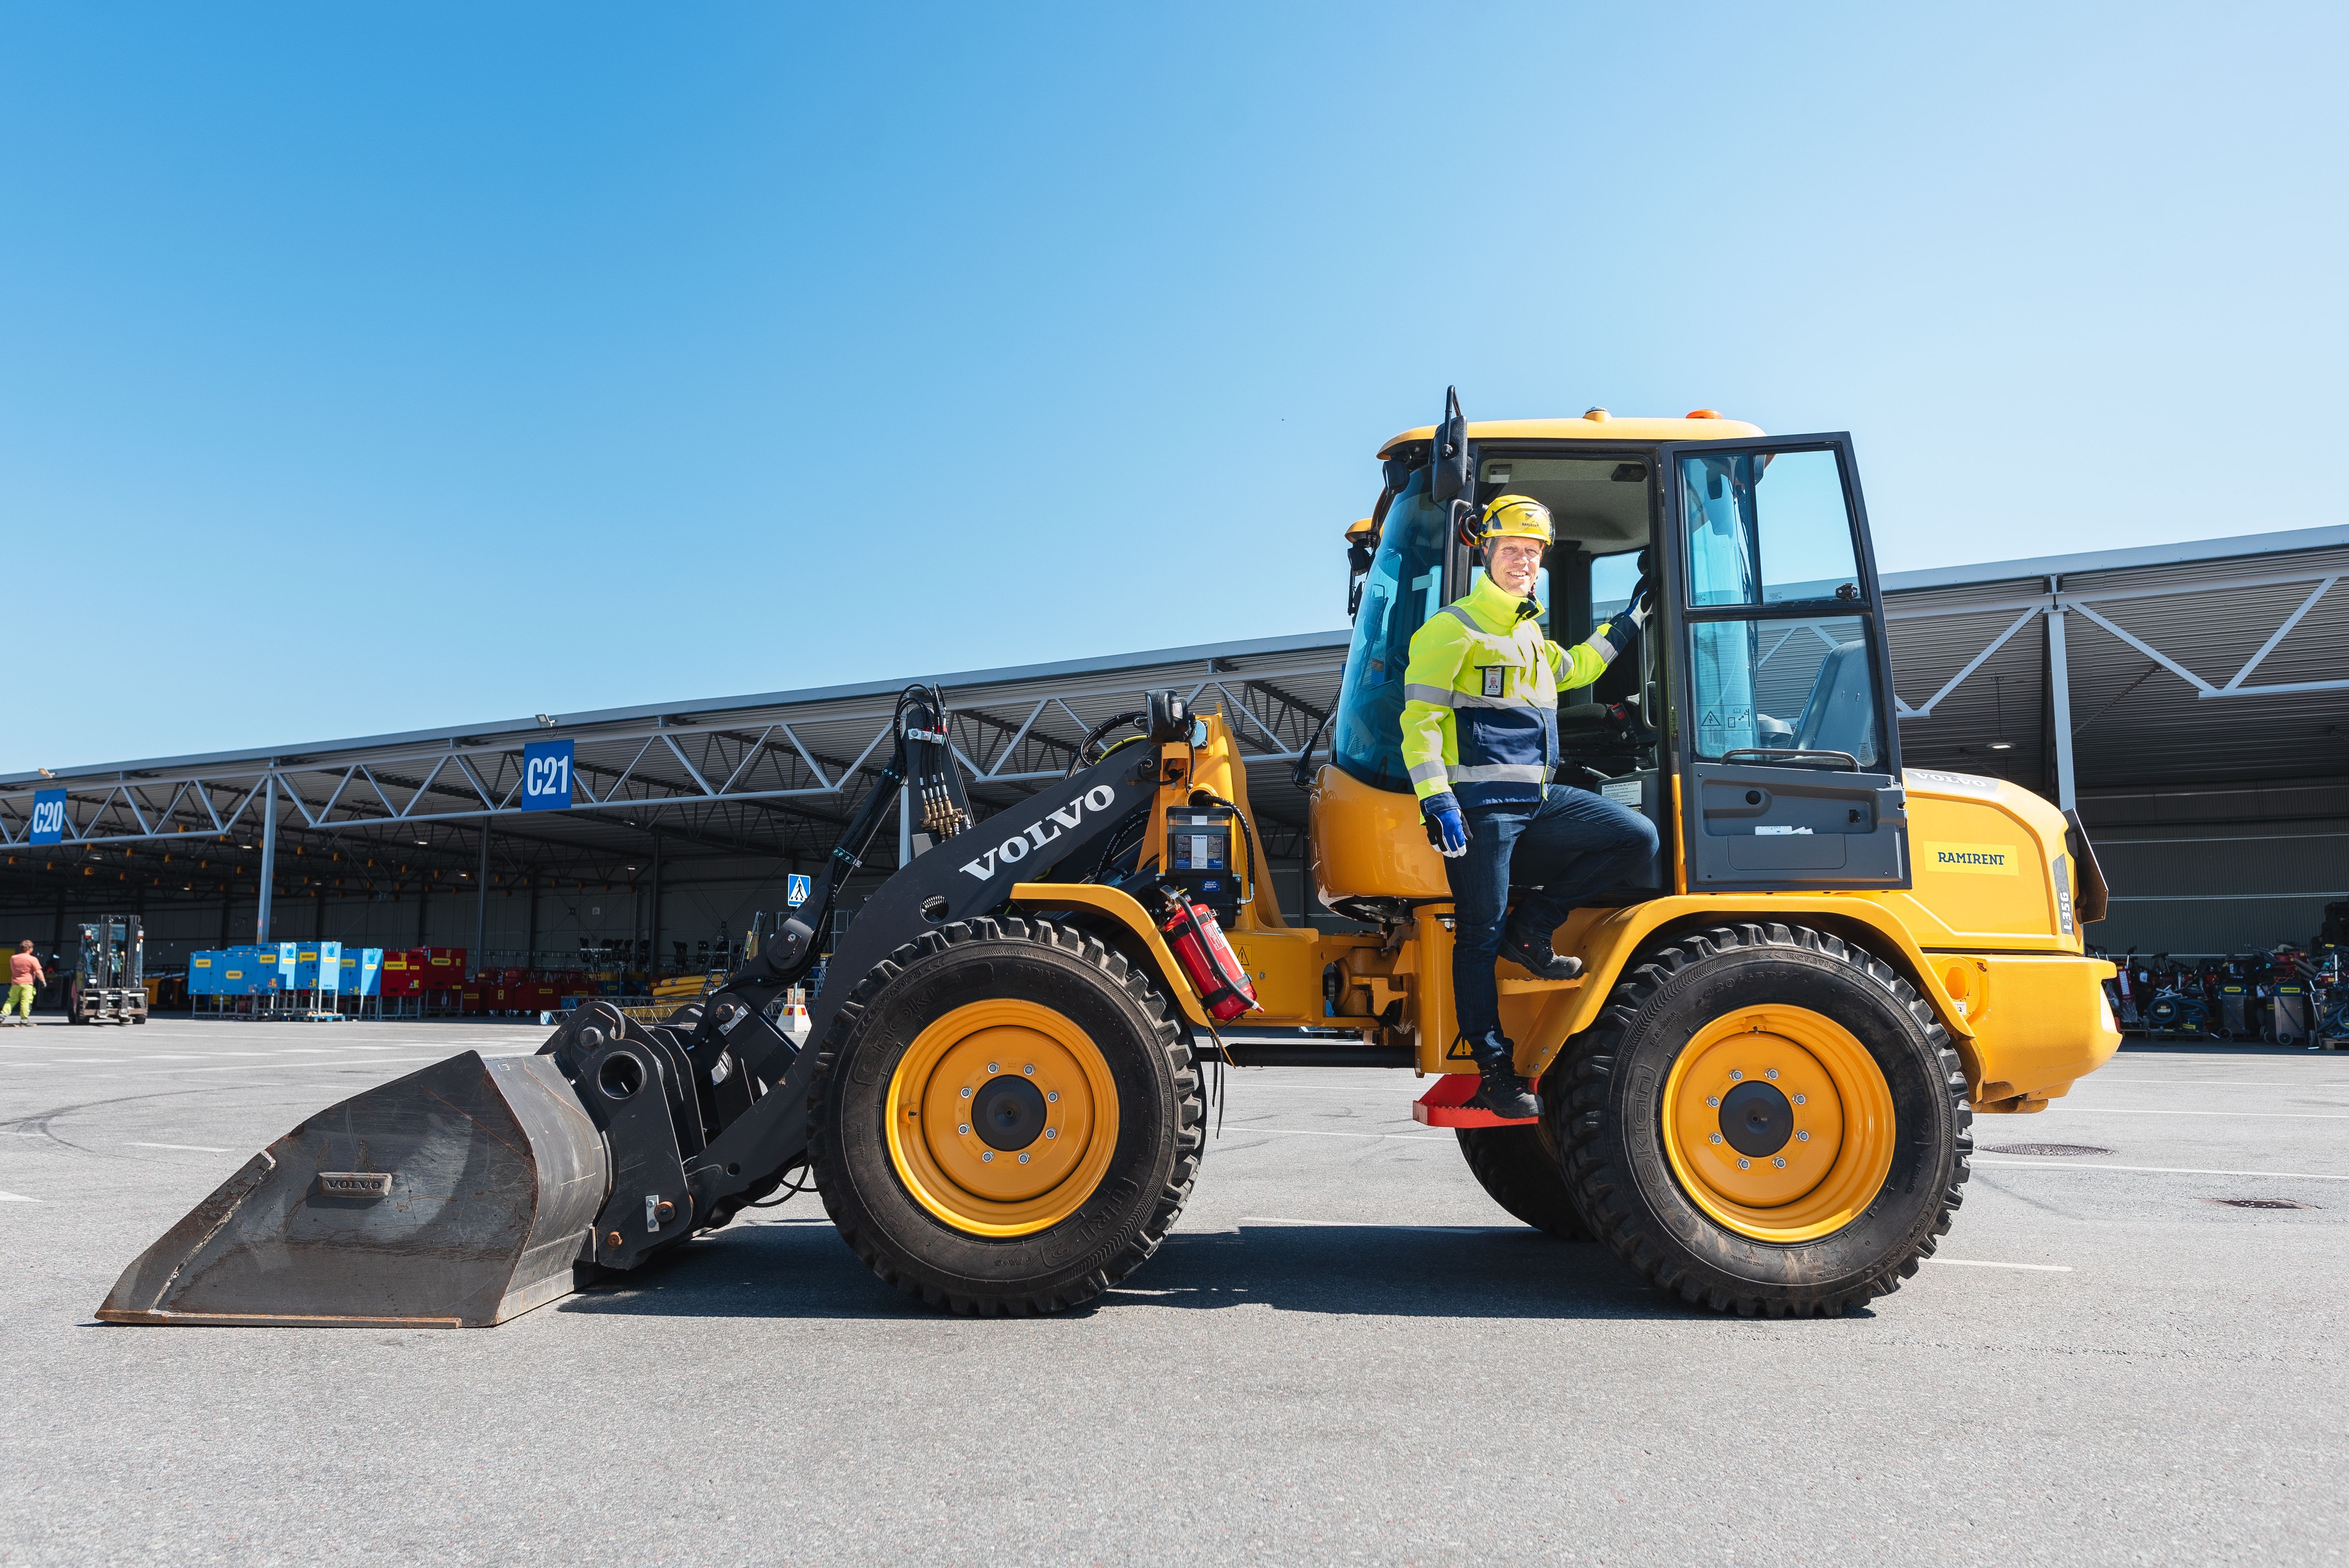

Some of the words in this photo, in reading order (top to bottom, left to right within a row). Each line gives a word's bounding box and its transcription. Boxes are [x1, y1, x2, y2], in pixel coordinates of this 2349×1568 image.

[527, 755, 568, 796] C21
[1910, 772, 1987, 787] VOLVO
[33, 801, 63, 833] C20
[959, 785, 1115, 881] VOLVO
[1938, 852, 2005, 865] RAMIRENT
[2060, 892, 2072, 930] L35G
[1787, 952, 1846, 973] ROTATION
[872, 969, 922, 1012] ROTATION
[1649, 1010, 1679, 1046] RADIAL
[1155, 1055, 1171, 1117] ROTATION
[326, 1180, 381, 1190] VOLVO
[1883, 1218, 1928, 1265] ROTATION
